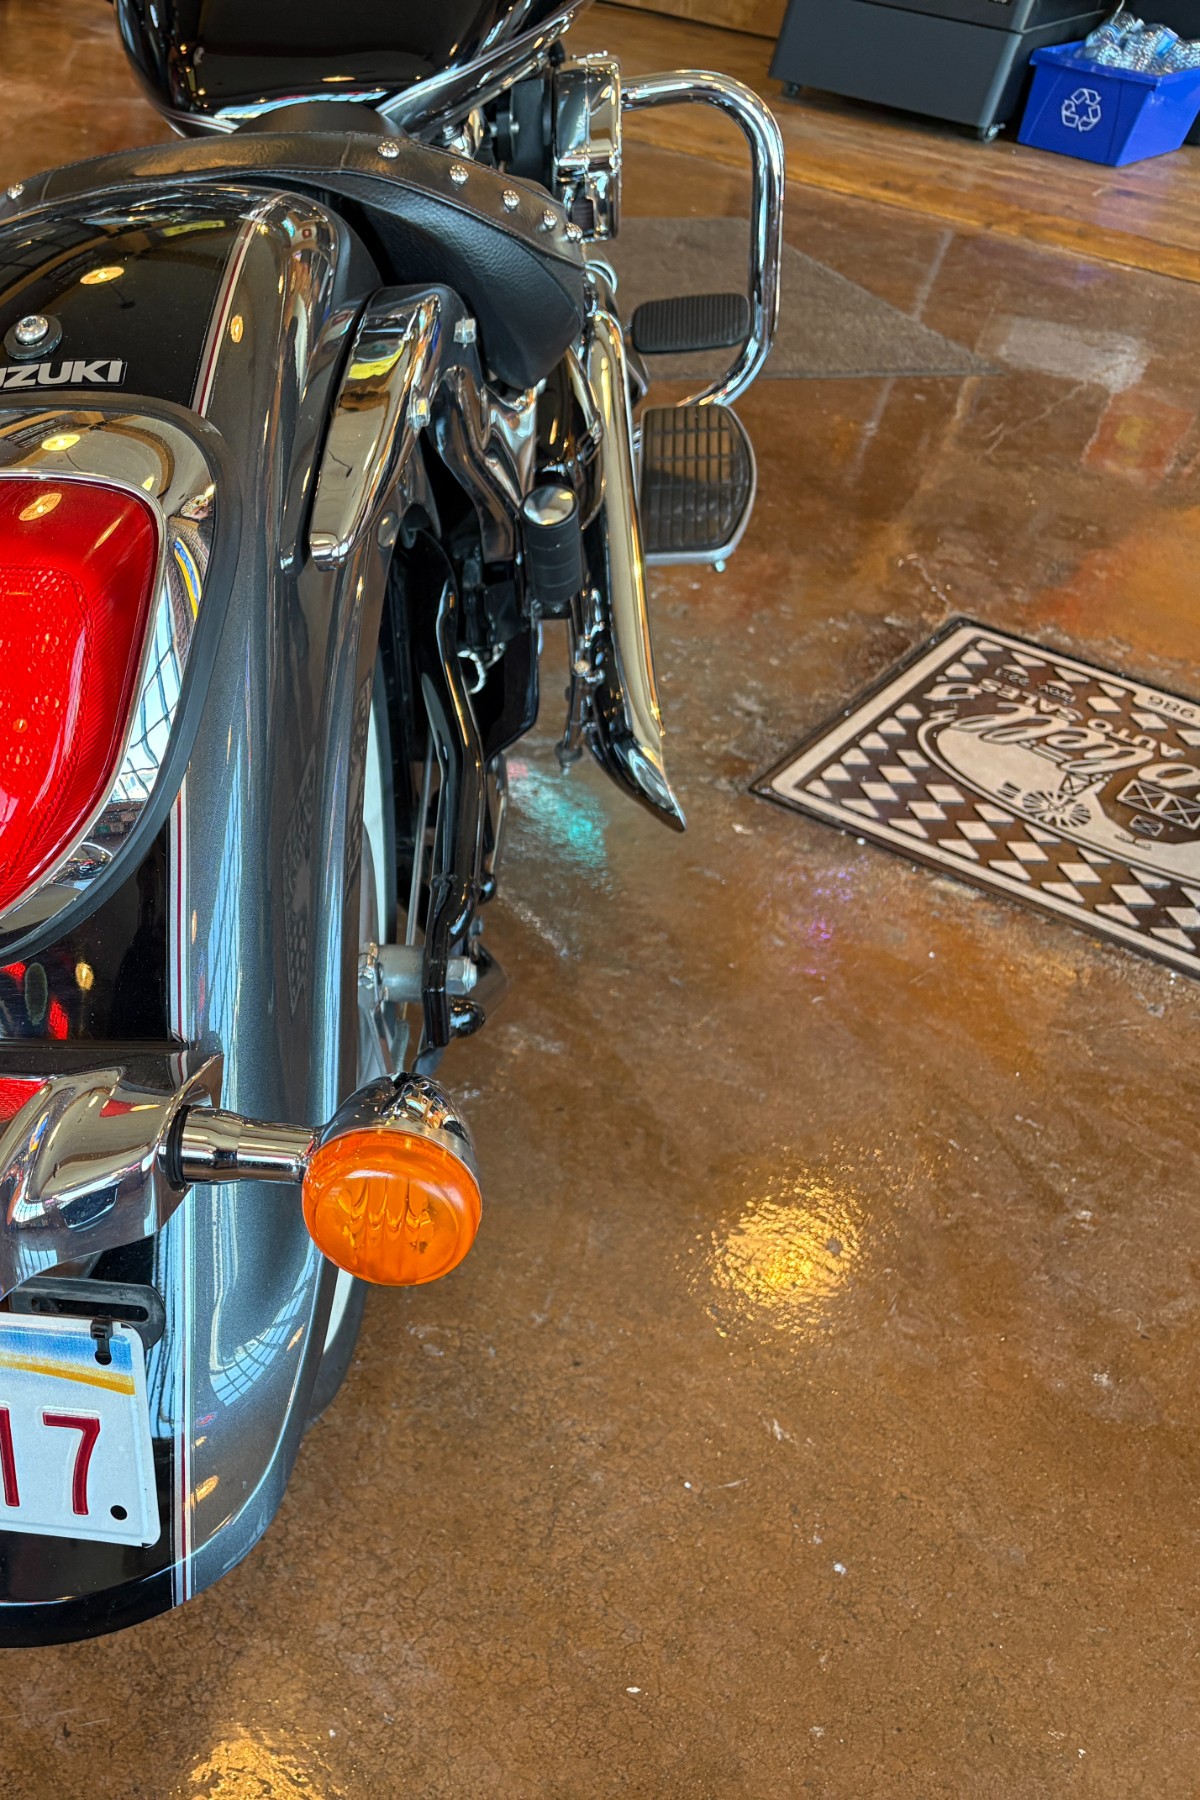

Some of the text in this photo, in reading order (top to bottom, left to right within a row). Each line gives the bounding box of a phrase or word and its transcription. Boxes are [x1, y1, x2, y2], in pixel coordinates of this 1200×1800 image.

[978, 678, 1185, 758] AUTO SALES
[1149, 695, 1200, 722] 986
